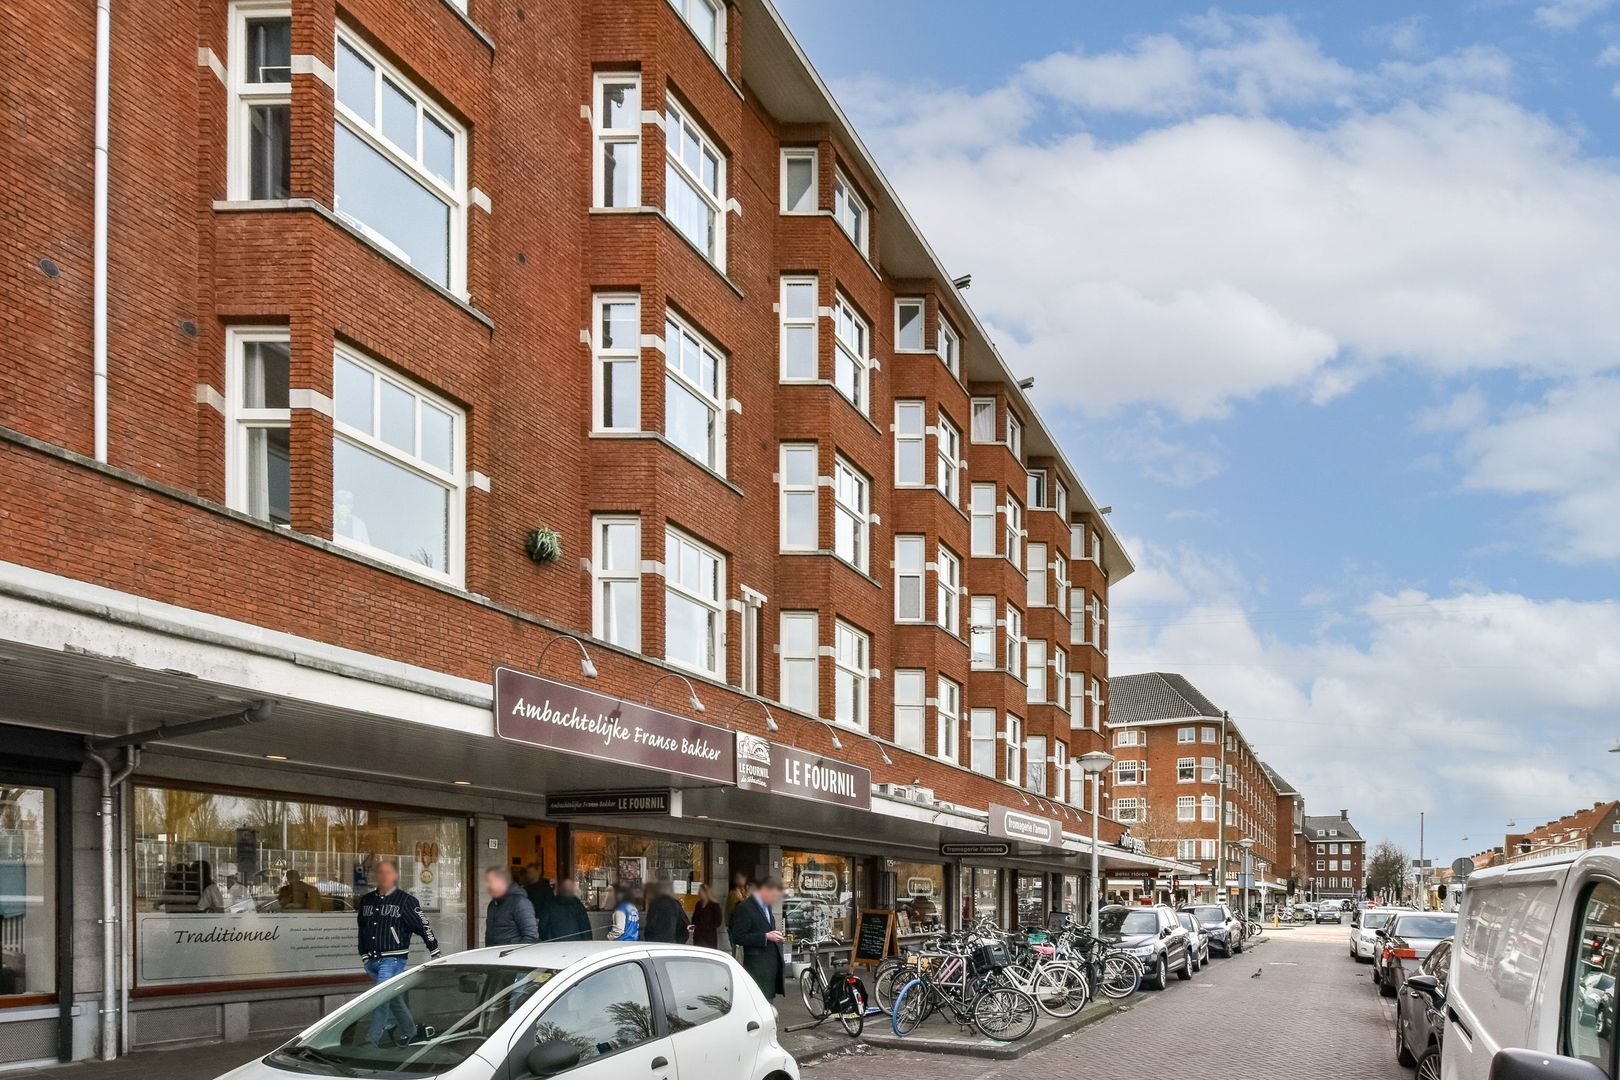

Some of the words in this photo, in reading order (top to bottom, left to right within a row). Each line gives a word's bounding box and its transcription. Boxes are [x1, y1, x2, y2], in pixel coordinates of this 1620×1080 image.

[512, 698, 631, 746] Ambachtelijke
[634, 727, 679, 752] Franse
[681, 737, 722, 762] Bakker
[739, 762, 746, 774] LE
[746, 764, 770, 779] FOURNIL
[785, 758, 801, 786] LE
[804, 763, 857, 798] FOURNIL
[618, 798, 628, 809] LE
[629, 797, 665, 809] FOURNIL
[174, 925, 280, 944] Traditionnel
